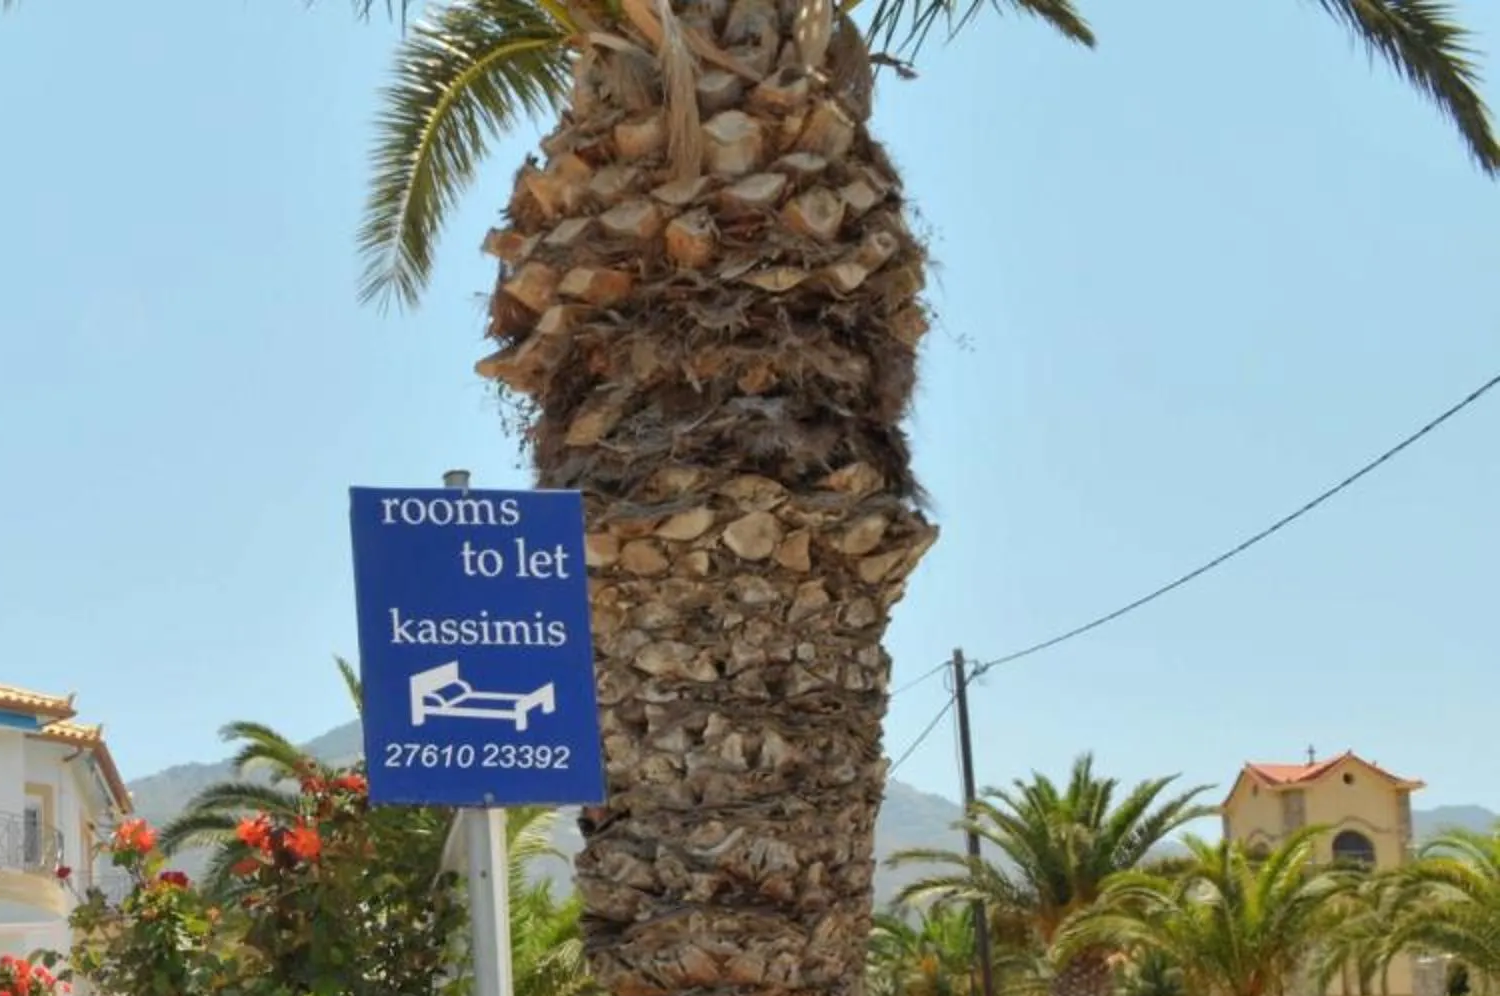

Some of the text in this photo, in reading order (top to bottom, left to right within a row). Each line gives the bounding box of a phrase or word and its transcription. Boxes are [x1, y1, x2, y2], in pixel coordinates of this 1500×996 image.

[380, 497, 520, 526] rooms
[461, 538, 570, 579] to let
[389, 607, 567, 647] kassimis
[385, 743, 571, 770] 27610 23392
